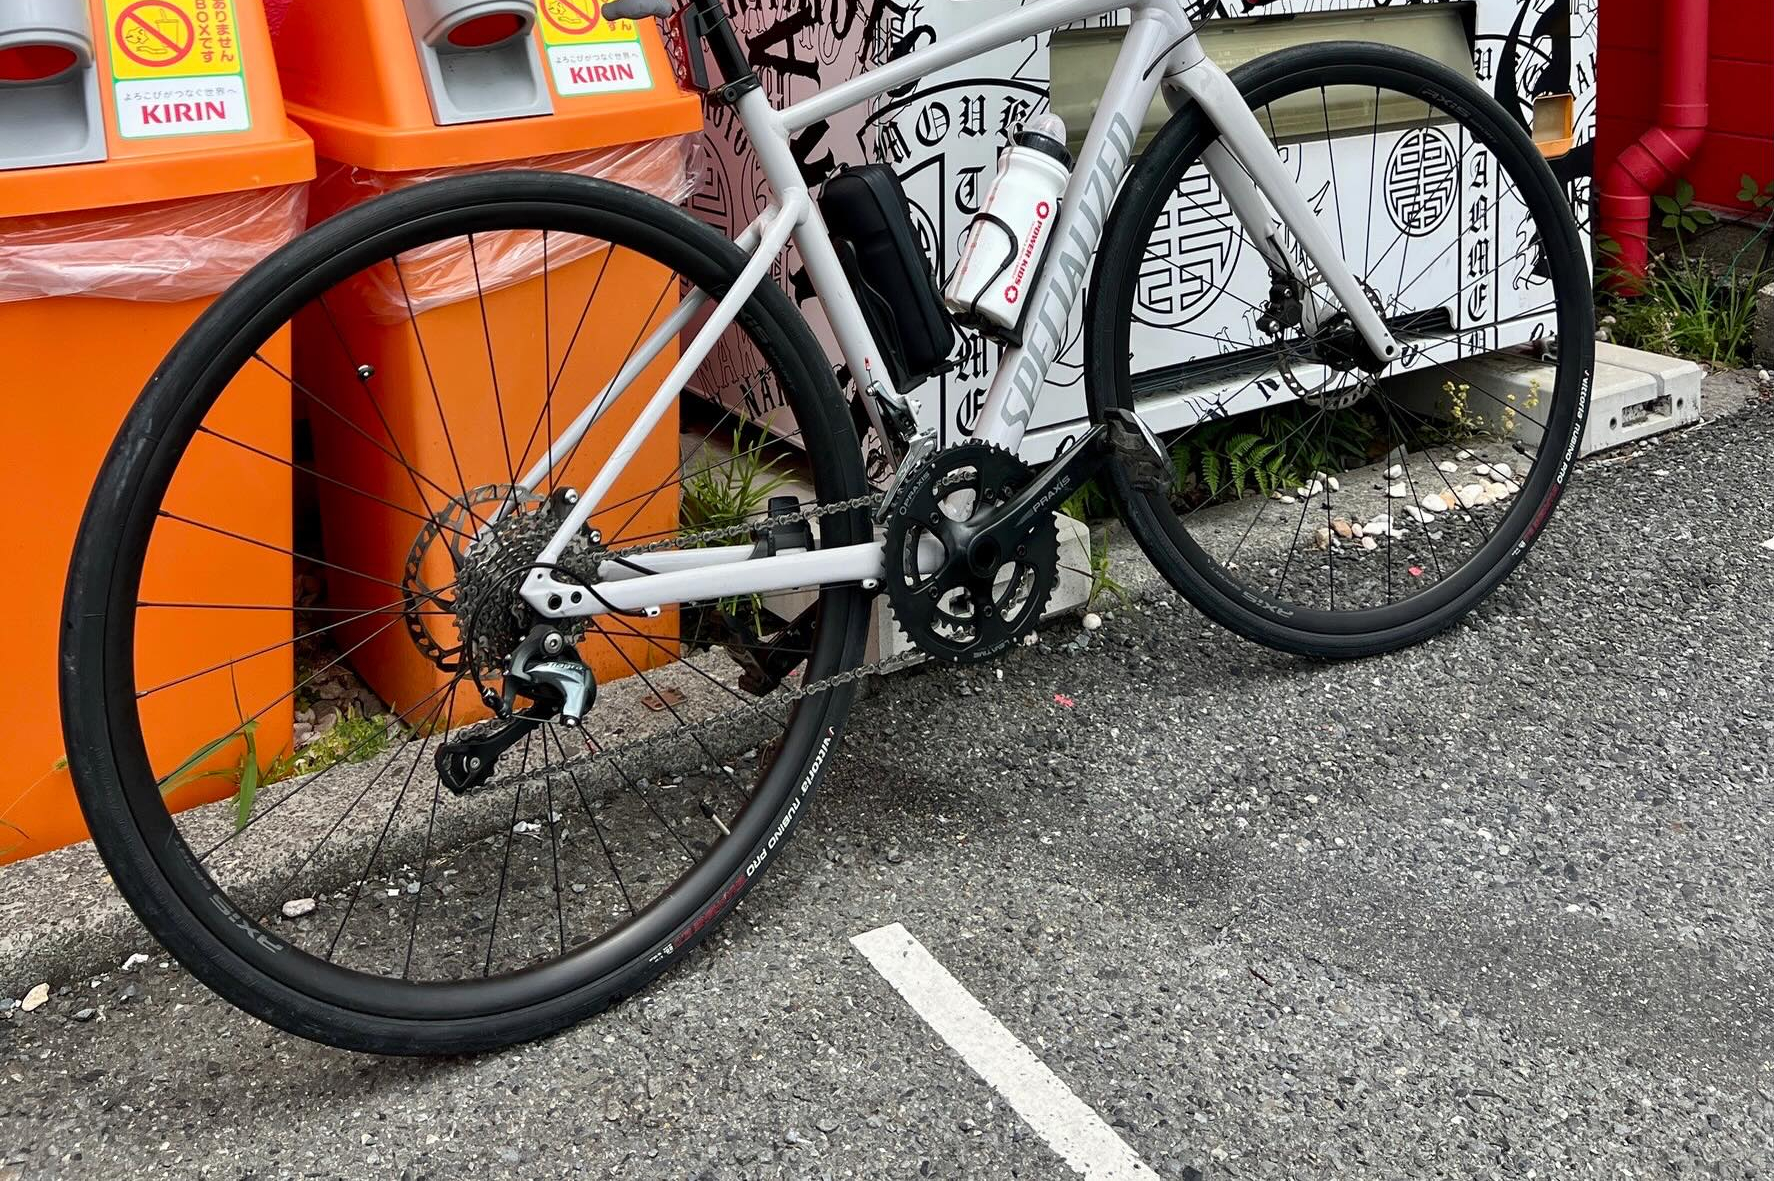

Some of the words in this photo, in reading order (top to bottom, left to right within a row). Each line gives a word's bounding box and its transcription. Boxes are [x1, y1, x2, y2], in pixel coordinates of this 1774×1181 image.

[569, 63, 635, 84] KIRIN
[141, 100, 226, 125] KIRIN
[1025, 220, 1043, 259] POWER
[1014, 259, 1028, 287] KIDS
[1577, 377, 1590, 420] vittoria
[1564, 423, 1581, 461] RUBINO
[904, 472, 931, 509] PRAXIS
[1556, 462, 1568, 485] PRO
[1033, 474, 1071, 513] PRAXIS
[800, 736, 832, 795] vittoria
[767, 797, 801, 851] RUBINO
[746, 848, 768, 877] PRO
